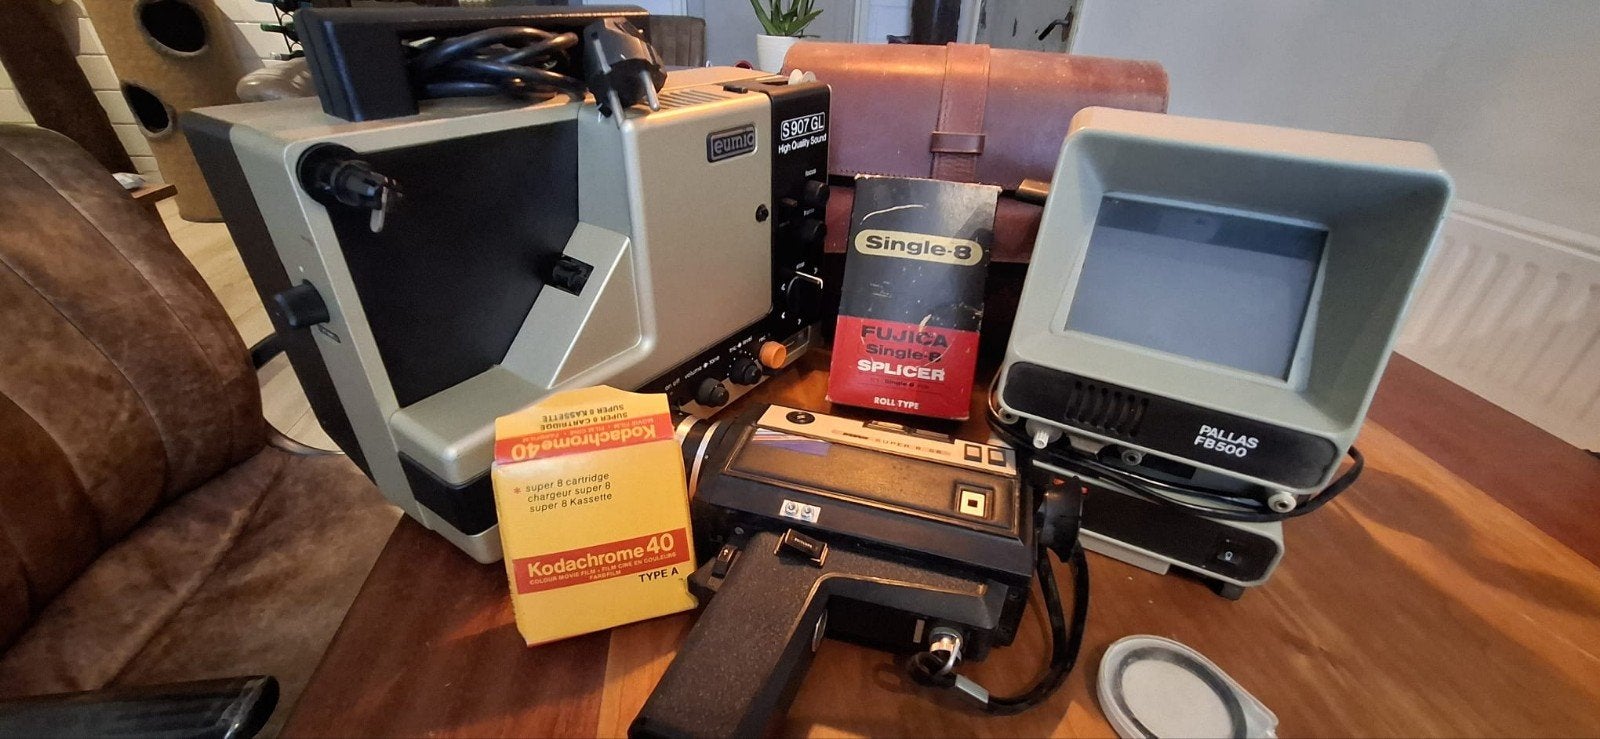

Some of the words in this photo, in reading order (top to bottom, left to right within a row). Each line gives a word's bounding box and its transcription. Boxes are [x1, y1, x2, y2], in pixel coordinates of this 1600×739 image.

[782, 122, 790, 138] S
[790, 118, 810, 135] 907
[811, 116, 824, 131] GL
[778, 143, 791, 154] High
[791, 139, 810, 151] Quality
[810, 133, 827, 145] Sound
[865, 235, 972, 260] Single-8
[861, 324, 949, 348] FUJICA
[865, 343, 942, 363] Single-8
[857, 359, 946, 382] SPLICER
[597, 403, 625, 414] SUPER
[873, 396, 896, 407] ROLL
[897, 400, 920, 410] TYPE
[540, 417, 590, 431] CARTRIDGE
[541, 409, 587, 423] KASSETTE
[600, 412, 628, 422] SUPER
[541, 424, 656, 450] Kodachrome
[1194, 435, 1248, 458] FB500
[1199, 424, 1259, 450] PALLAS
[511, 443, 537, 461] 40
[526, 480, 554, 493] super
[557, 478, 563, 488] 8
[565, 473, 610, 487] cartridge
[527, 489, 572, 503] chargeur
[574, 484, 602, 496] super
[605, 481, 611, 490] 8
[529, 501, 558, 513] super
[561, 499, 568, 508] 8
[570, 493, 613, 507] Kassette
[527, 545, 645, 578] Kodachrome
[646, 533, 674, 555] 40
[529, 576, 558, 586] COLOUR
[558, 572, 580, 581] MOVIE
[580, 569, 596, 577] FILM
[601, 565, 617, 573] FILM
[634, 559, 643, 567] EN
[643, 551, 677, 564] COULEURS
[638, 568, 669, 583] TYPE
[671, 566, 679, 576] A
